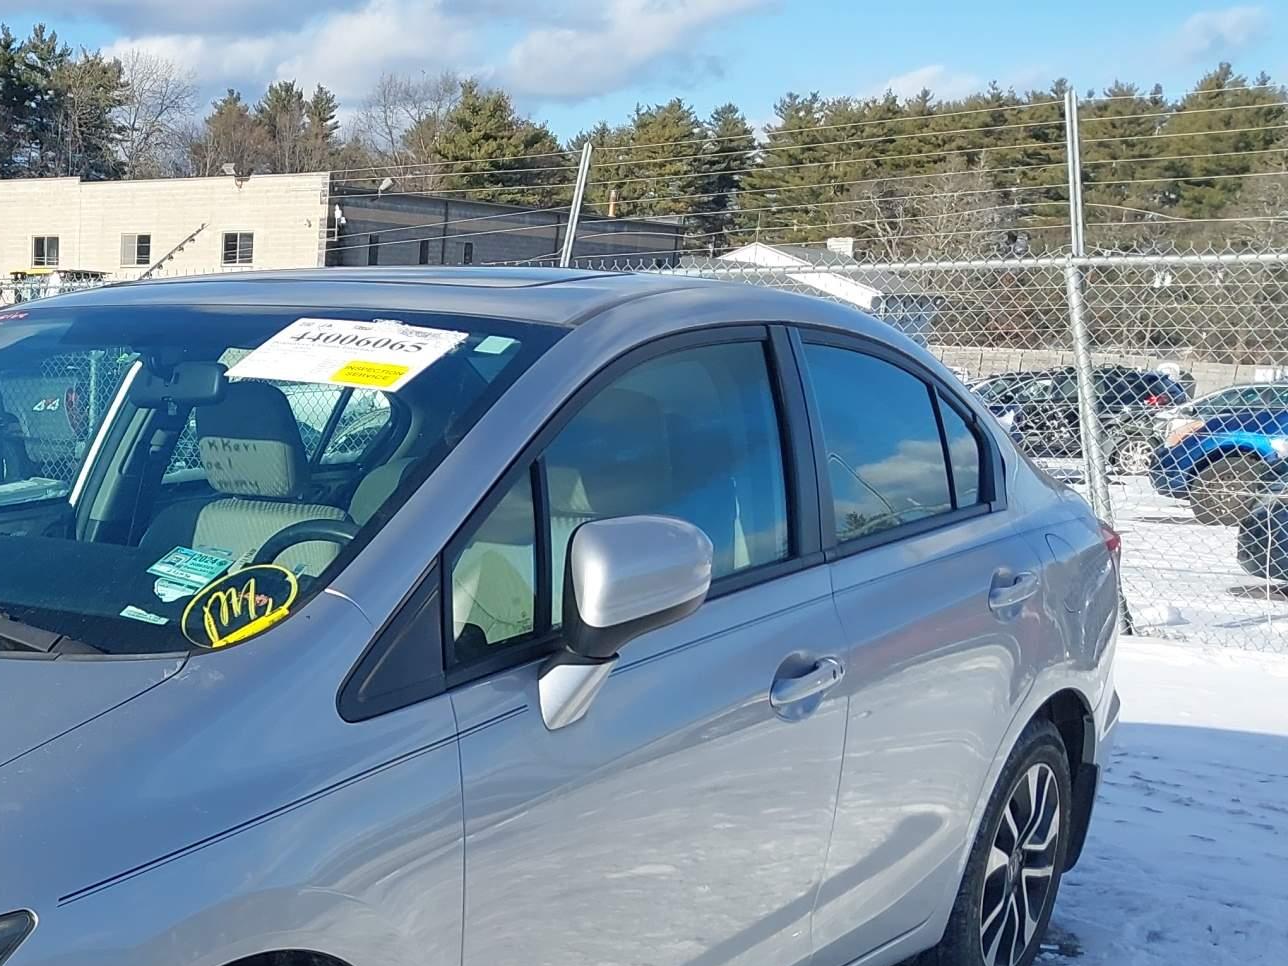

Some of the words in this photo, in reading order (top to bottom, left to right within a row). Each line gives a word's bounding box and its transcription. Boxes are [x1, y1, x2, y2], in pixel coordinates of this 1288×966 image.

[291, 331, 429, 353] 44006065
[344, 365, 405, 376] INSPECTION
[344, 371, 390, 381] SERVICE
